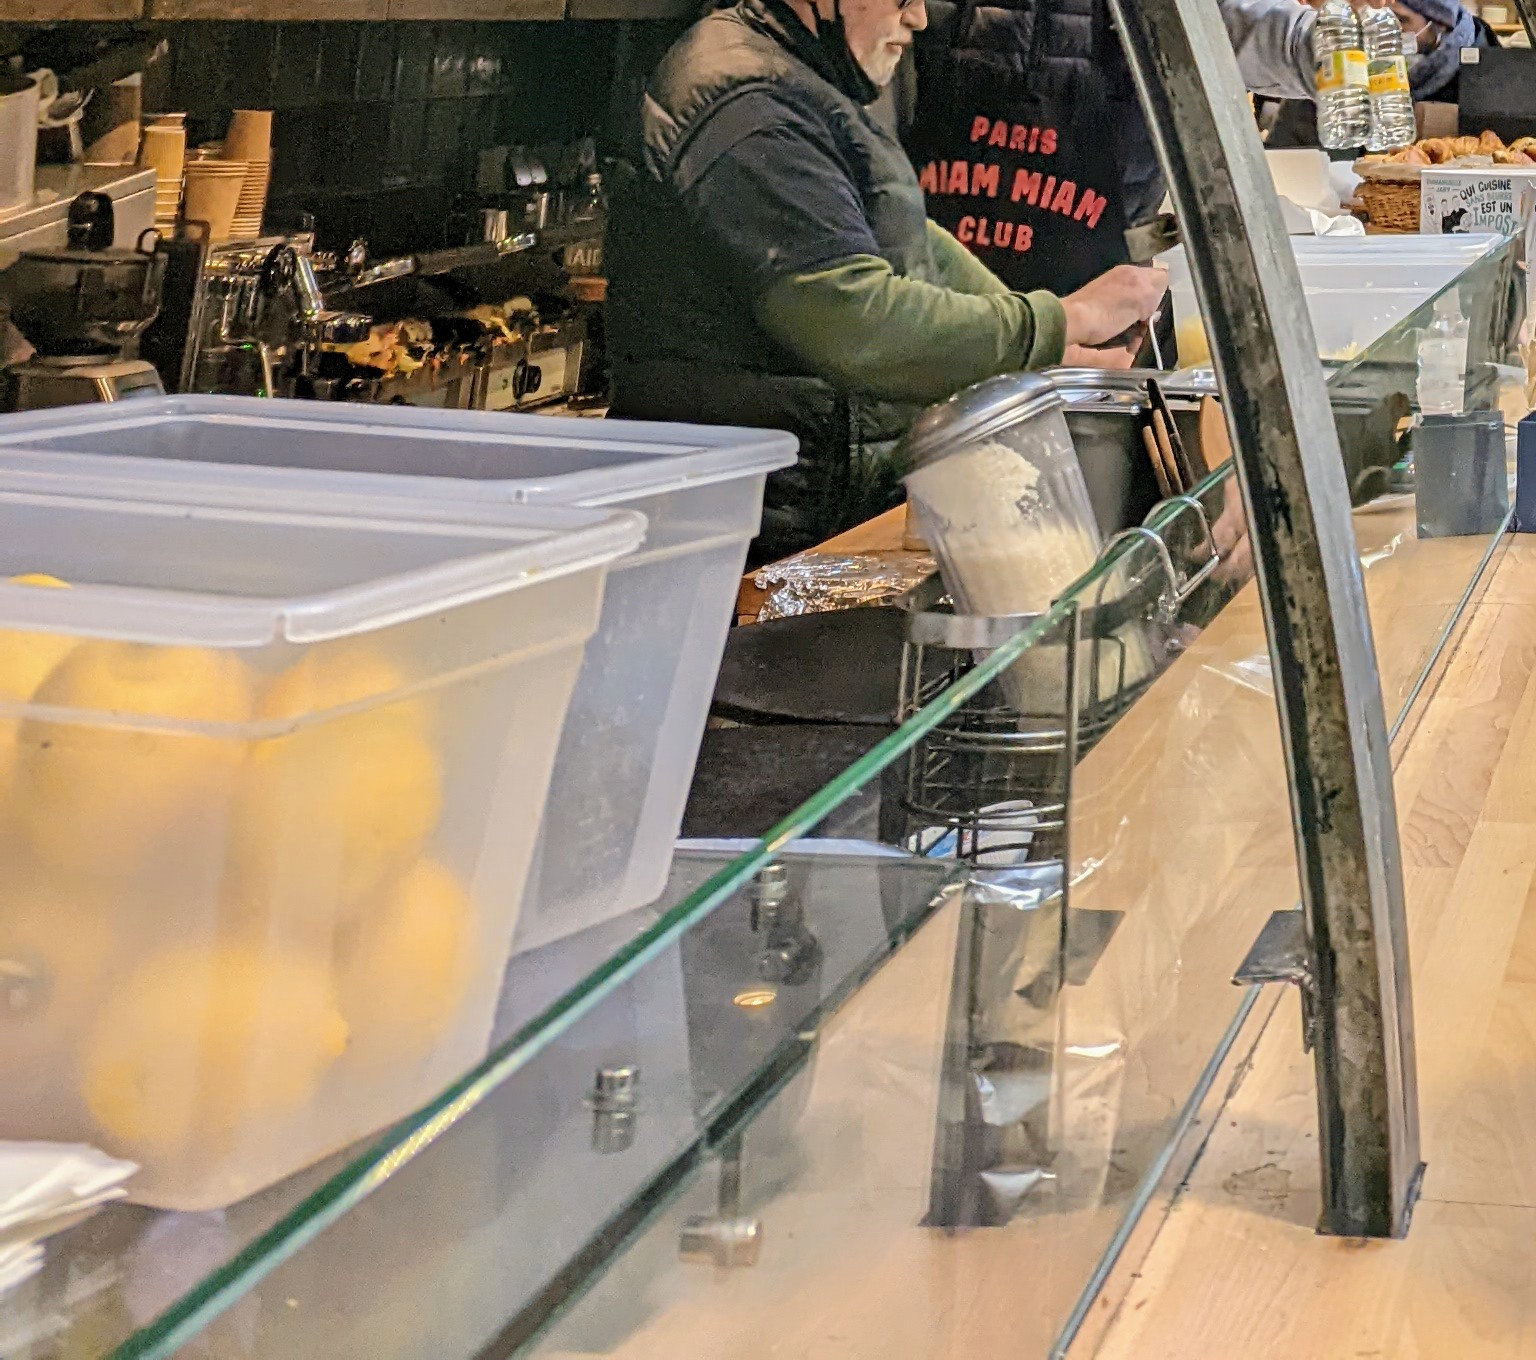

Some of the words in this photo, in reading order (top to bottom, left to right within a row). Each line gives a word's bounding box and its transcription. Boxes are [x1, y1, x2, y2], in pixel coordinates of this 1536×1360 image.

[969, 114, 1059, 155] PARIS
[918, 159, 1001, 199] MIAM
[1010, 167, 1109, 230] MIAM
[1460, 183, 1476, 201] QUI
[1478, 178, 1512, 193] CUISINE
[1473, 206, 1519, 237] IMPOST
[1480, 200, 1497, 215] EST
[1500, 201, 1513, 214] UN
[955, 214, 1035, 253] CLUB
